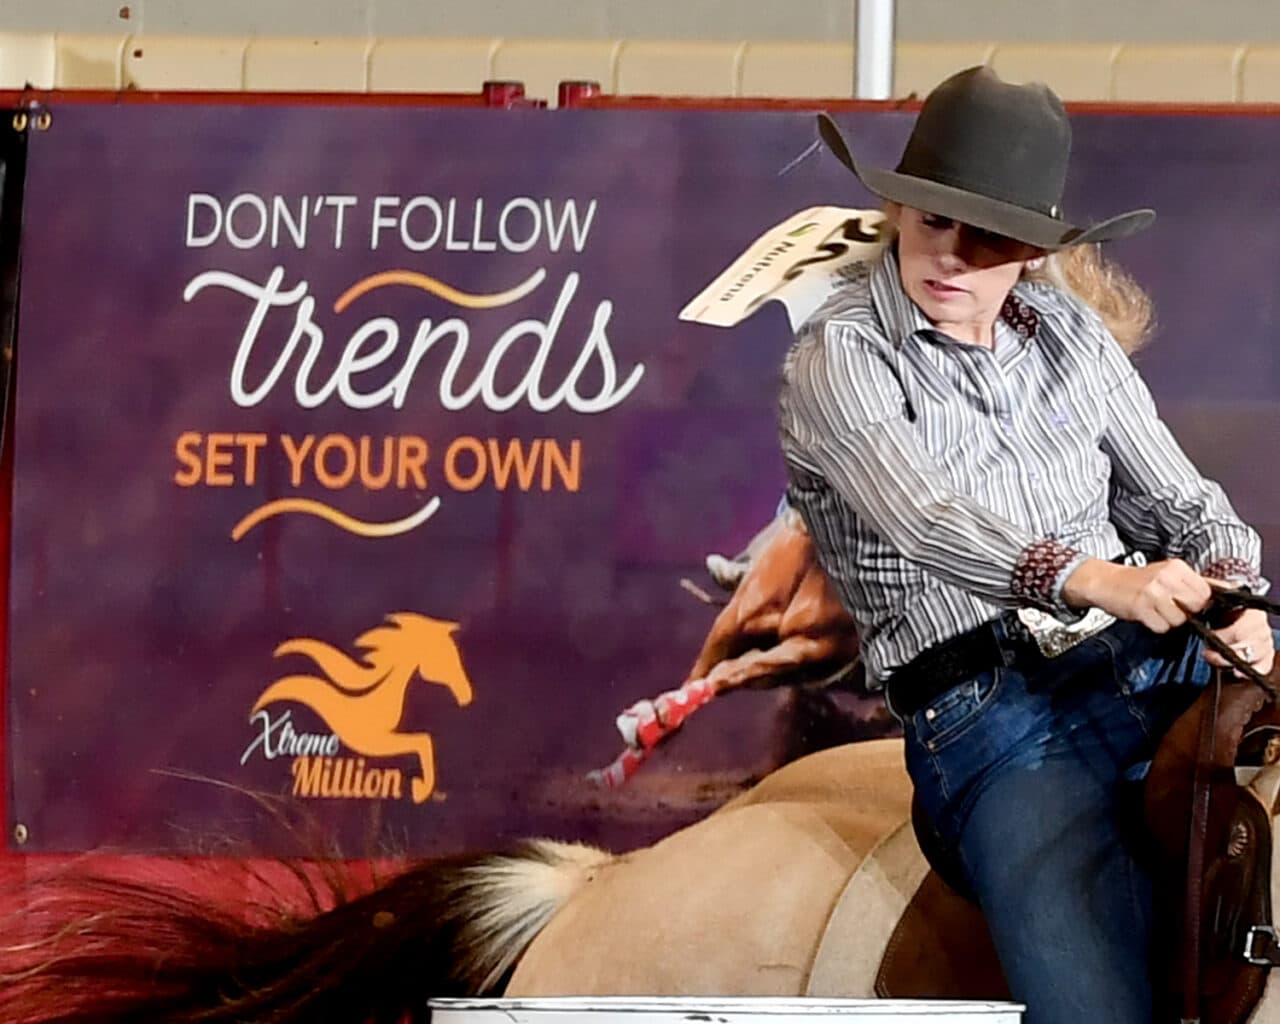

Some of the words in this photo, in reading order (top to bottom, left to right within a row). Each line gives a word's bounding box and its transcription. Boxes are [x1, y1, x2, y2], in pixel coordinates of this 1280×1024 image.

[185, 193, 358, 250] DON'T
[371, 196, 597, 253] FOLLOW
[174, 432, 268, 487] SET
[279, 433, 430, 490] YOUR
[444, 436, 582, 492] OWN
[240, 709, 340, 766] Xtreme
[292, 756, 402, 799] Million
